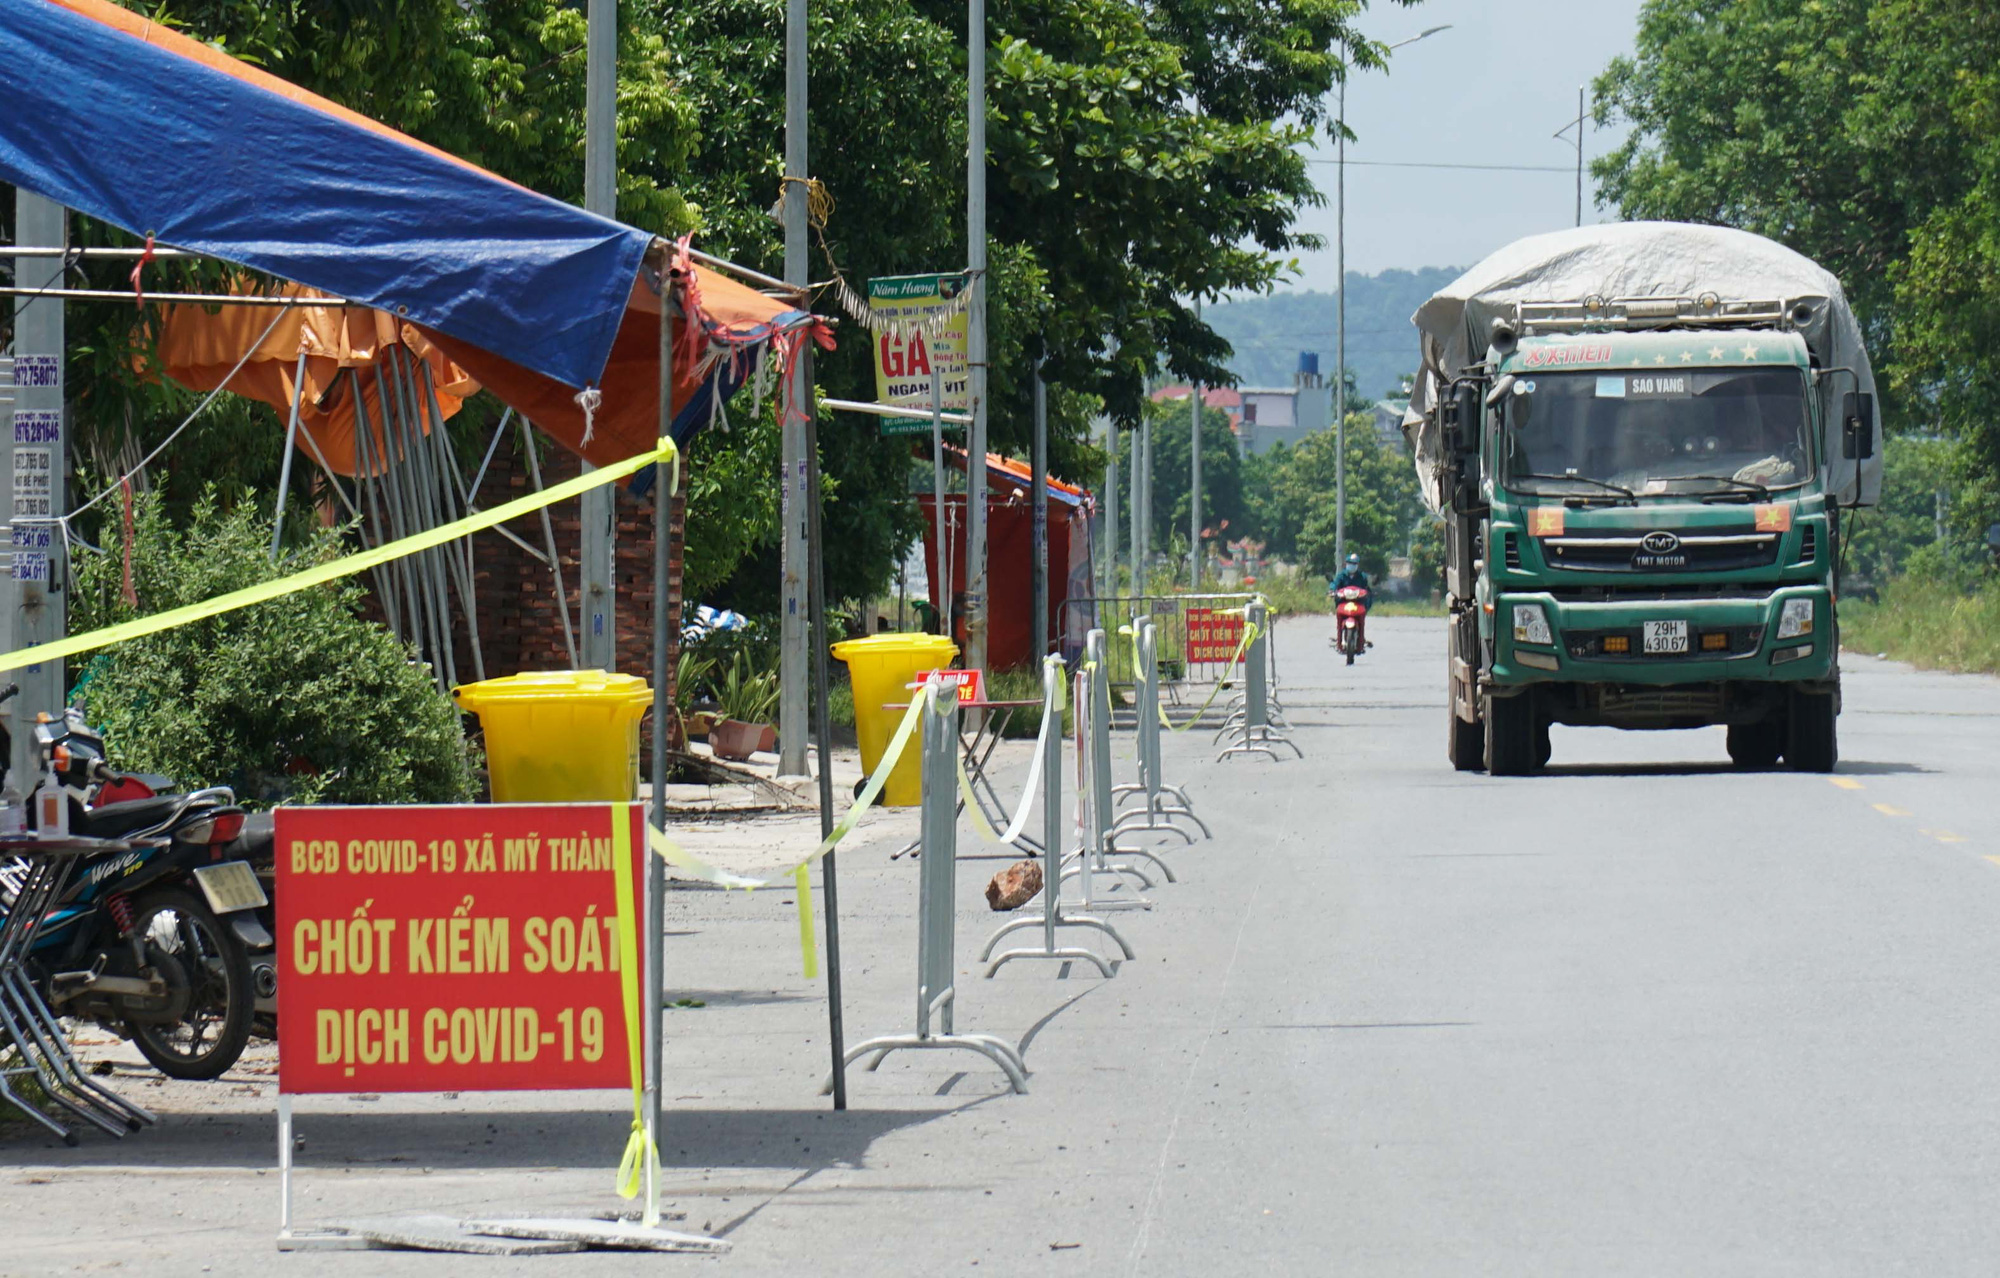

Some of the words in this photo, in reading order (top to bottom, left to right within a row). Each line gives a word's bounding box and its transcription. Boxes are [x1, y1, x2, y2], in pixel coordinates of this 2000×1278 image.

[888, 383, 930, 396] NGAN
[1632, 378, 1654, 394] SAO
[1656, 377, 1685, 393] VANG
[1647, 537, 1673, 548] TMT
[1636, 556, 1654, 566] TMT
[1656, 556, 1685, 566] MOTOR
[1654, 622, 1678, 636] 29H
[1645, 637, 1687, 651] 430.67
[959, 685, 974, 700] TẾ
[291, 839, 340, 874] BCĐ
[346, 838, 457, 875] COVID-19
[463, 832, 497, 873] XÃ
[503, 832, 541, 873] MỸ
[547, 830, 616, 872] THÀN
[91, 852, 140, 885] Wave
[294, 899, 396, 975] CHỐT
[408, 894, 510, 974] KIỂM
[316, 1007, 409, 1077] DỊCH
[422, 1006, 605, 1065] COVID-19
